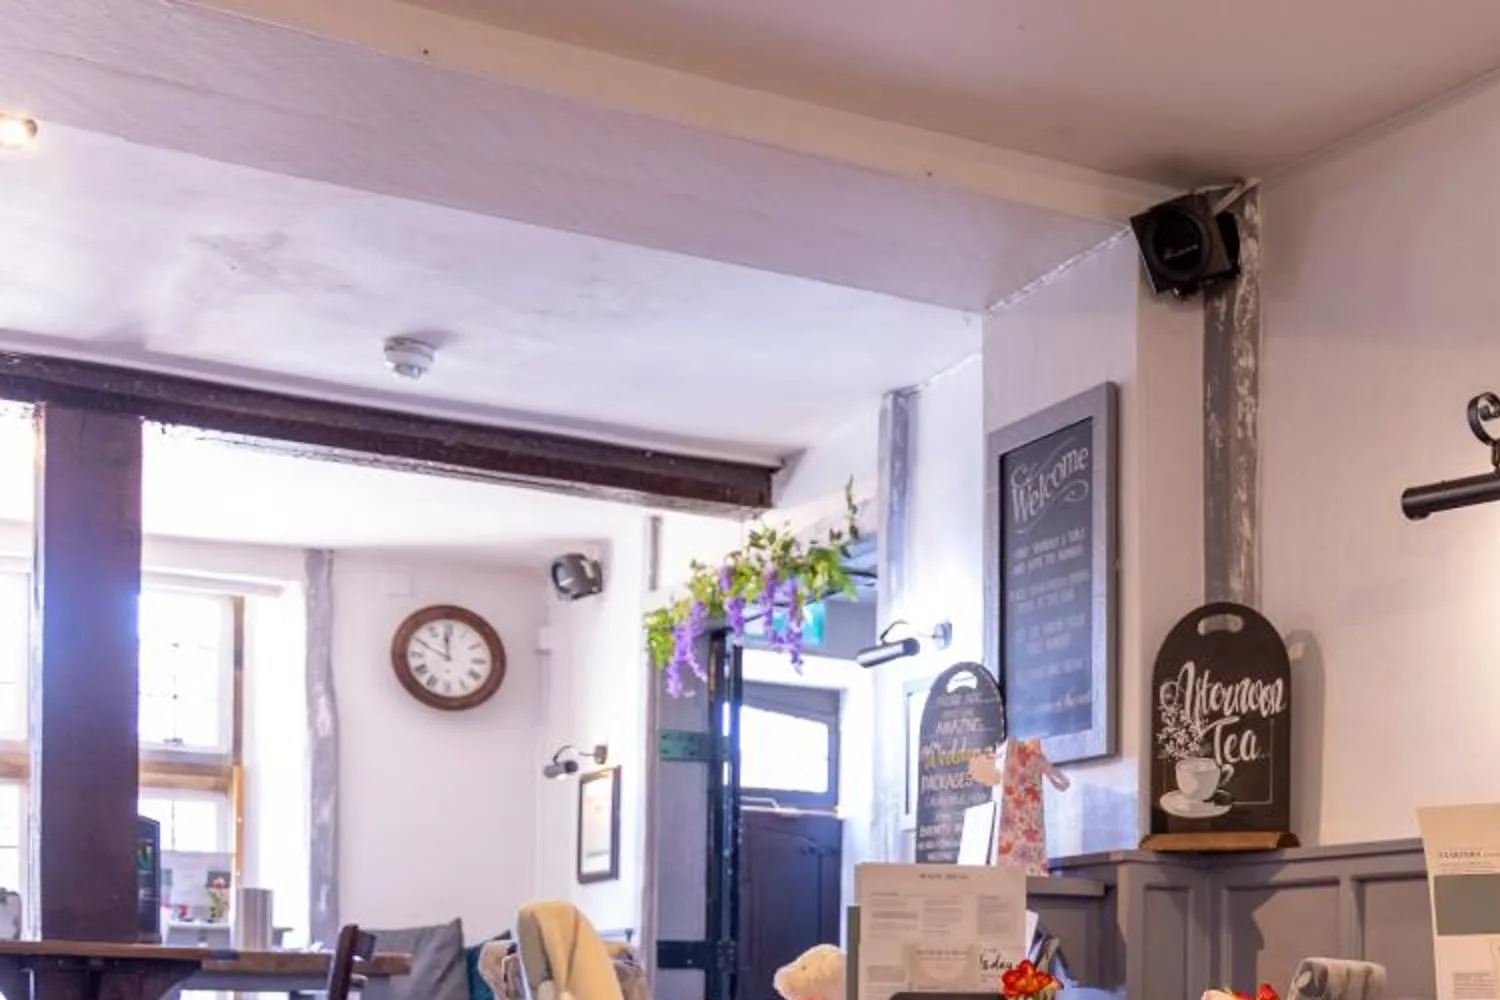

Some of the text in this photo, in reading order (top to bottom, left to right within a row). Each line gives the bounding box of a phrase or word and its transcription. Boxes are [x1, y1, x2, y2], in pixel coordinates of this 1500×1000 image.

[1011, 446, 1089, 523] Welcome
[1159, 661, 1285, 727] Afternoon
[1199, 716, 1260, 766] Tea
